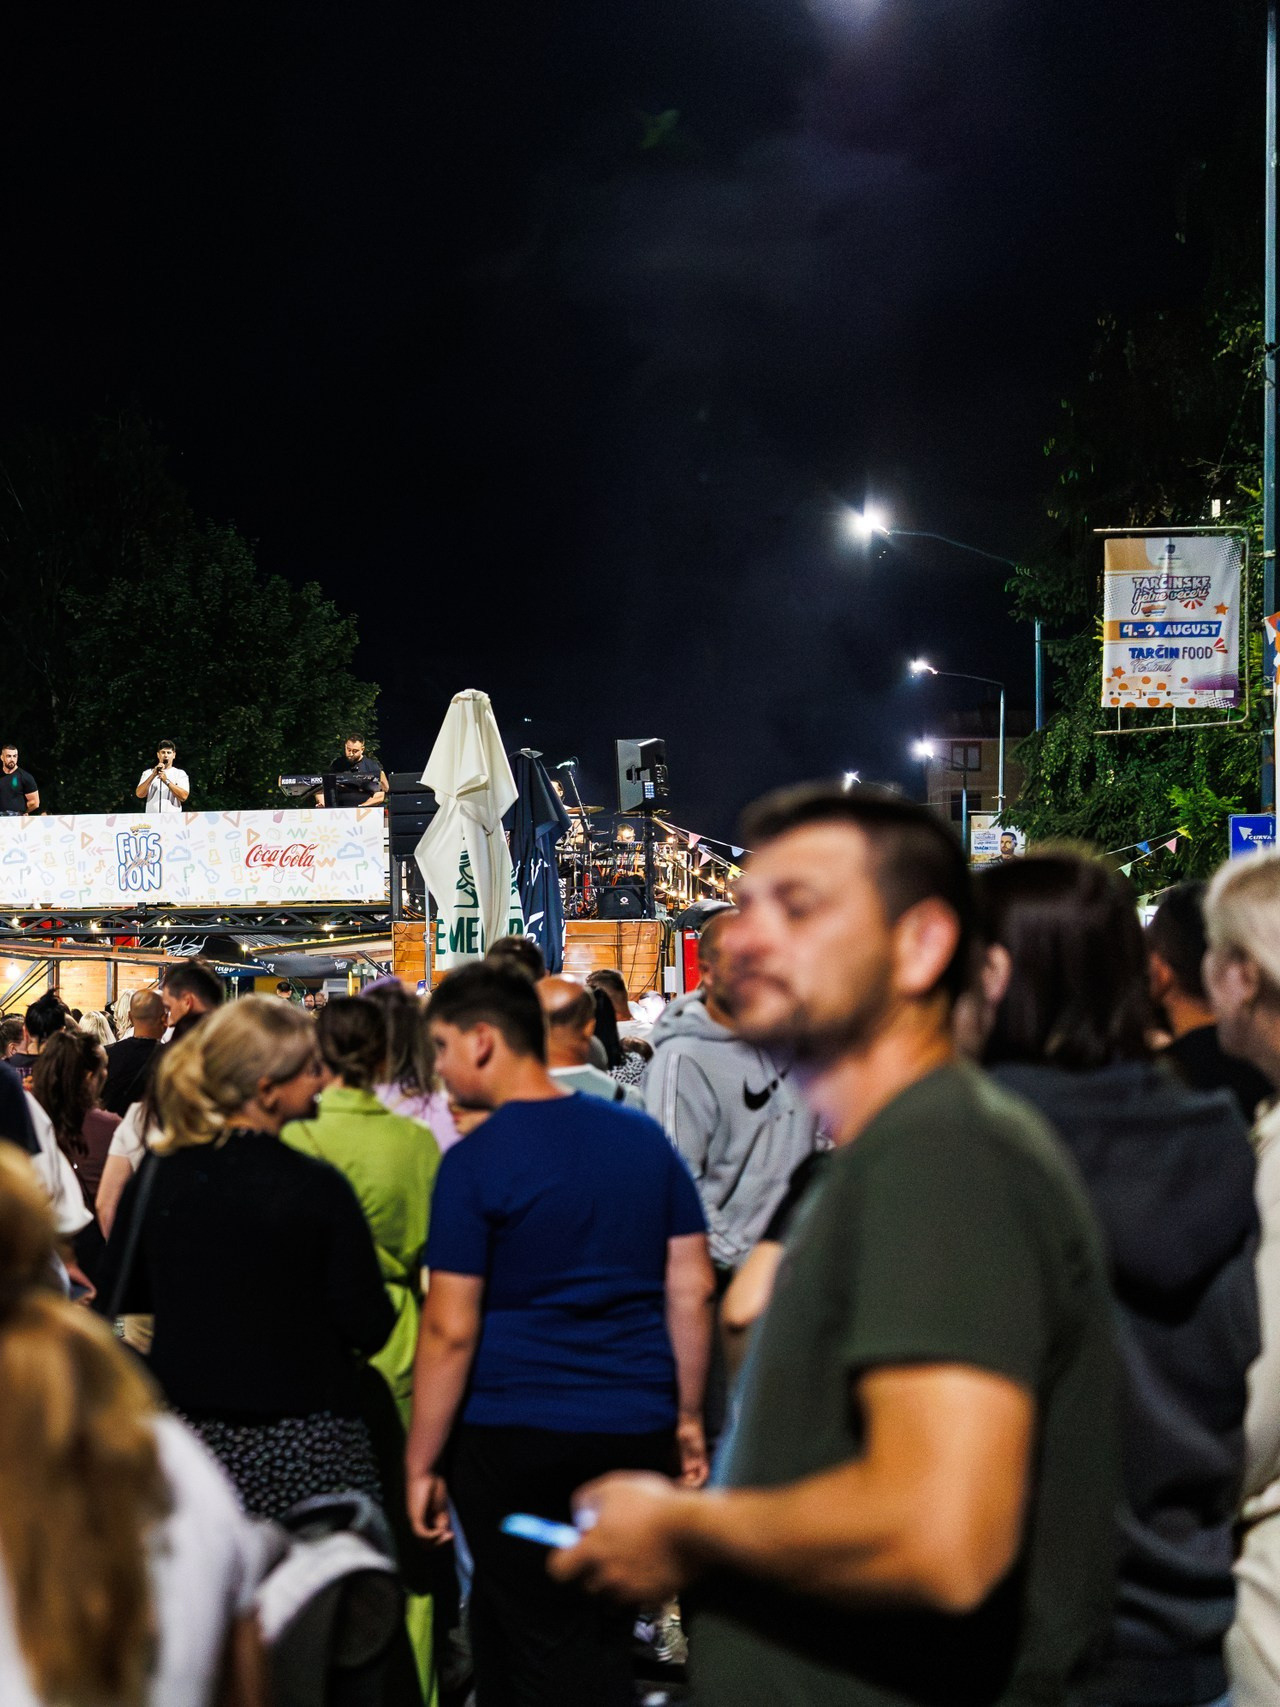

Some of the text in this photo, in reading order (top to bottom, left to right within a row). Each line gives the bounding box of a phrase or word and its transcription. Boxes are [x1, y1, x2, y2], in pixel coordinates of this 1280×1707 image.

[1132, 574, 1211, 589] TARČINSKE
[1122, 624, 1219, 636] 4.-9. AUGUST
[1128, 644, 1213, 660] TARČIN FOOD
[245, 843, 320, 868] Coca-Cola
